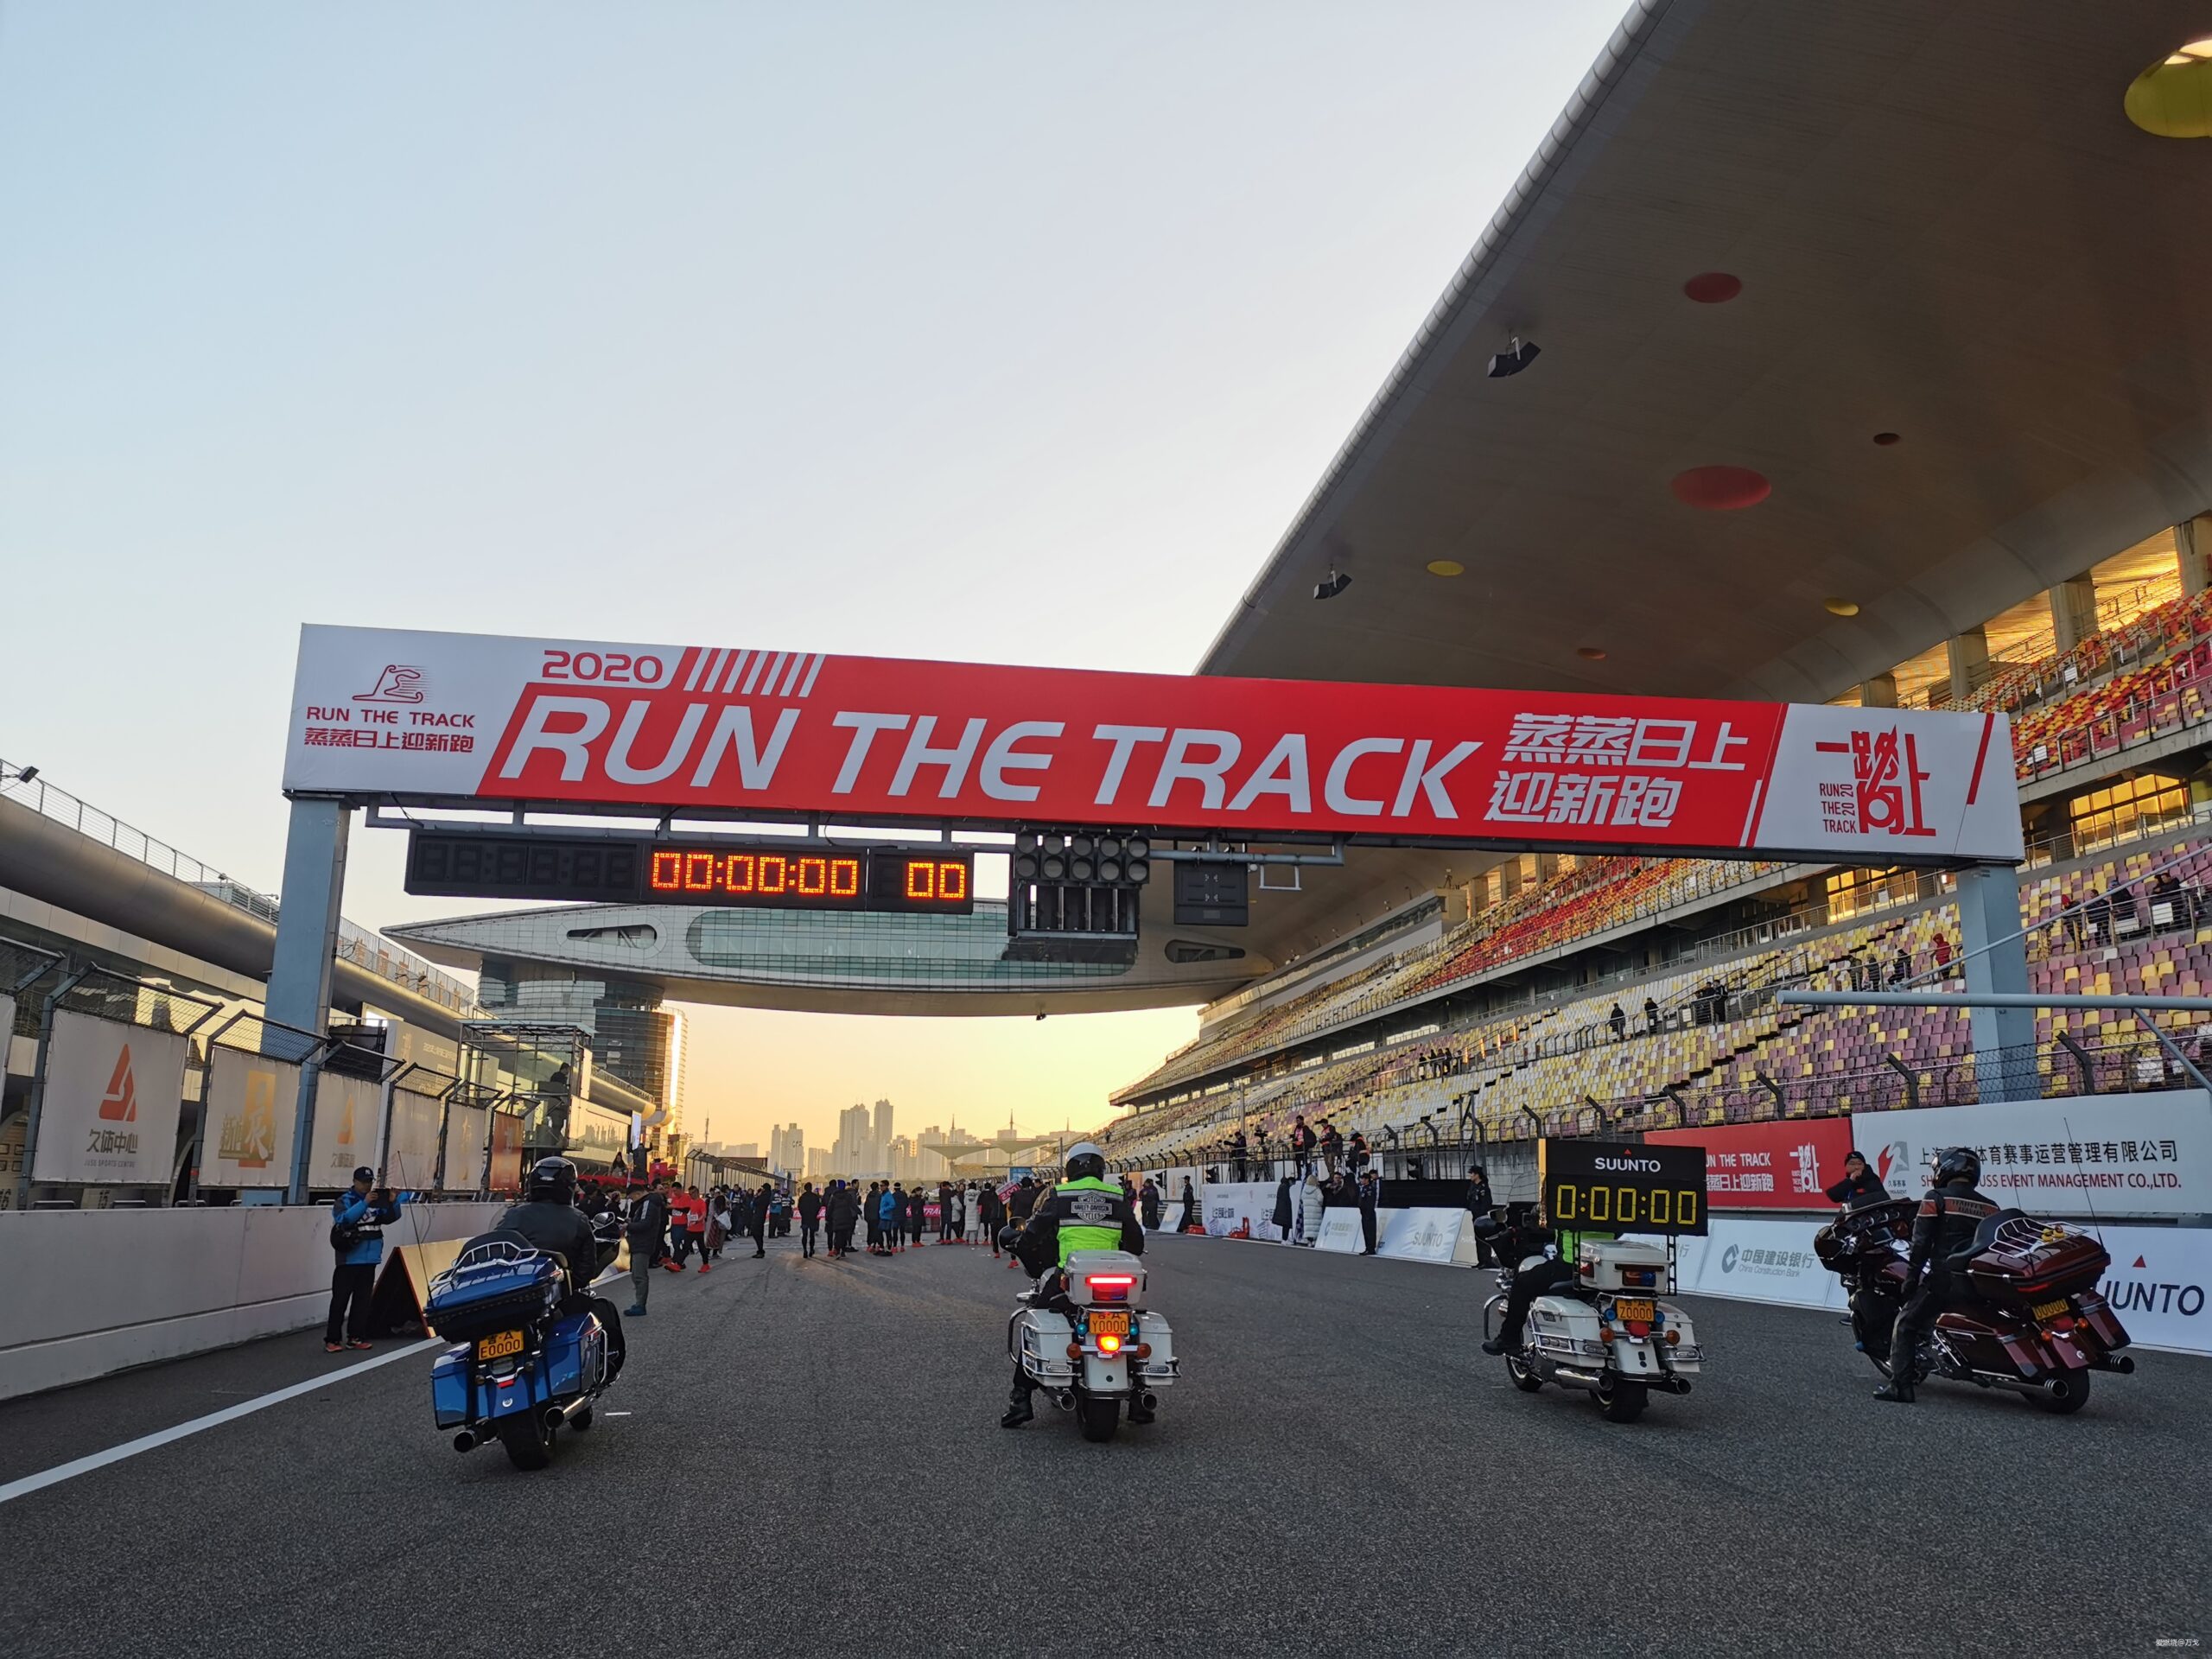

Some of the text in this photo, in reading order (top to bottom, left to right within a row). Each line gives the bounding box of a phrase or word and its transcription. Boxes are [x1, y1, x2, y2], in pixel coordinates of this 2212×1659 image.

[543, 650, 663, 683] 2020
[306, 706, 475, 728] RUN THE TRACK
[304, 728, 474, 753] 蒸蒸日上迎新跑
[1501, 712, 1748, 771] 蒸蒸日上
[499, 695, 1484, 820] RUN THE TRACK
[1483, 769, 1682, 828] 迎新跑
[1820, 783, 1840, 798] RUN
[1821, 801, 1840, 815] THE
[1822, 819, 1857, 834] TRACK
[652, 852, 965, 899] 00:00:00 00
[1719, 1154, 1737, 1167] THE
[1739, 1153, 1771, 1166] TRACK
[1919, 1140, 2177, 1166] 上体育赛事运营管理有限公司
[1594, 1157, 1662, 1173] SUUNTO
[1707, 1173, 1774, 1192] 蒸日上迎新跑
[1979, 1174, 1999, 1187] USS
[2000, 1174, 2035, 1188] EVENT
[2037, 1173, 2125, 1188] MANAGEMENT
[1556, 1185, 1697, 1225] 0:00:00
[1412, 1230, 1444, 1247] SUUNTO
[1741, 1249, 1815, 1268] 中国建设银行
[2104, 1281, 2204, 1316] UNTO
[1619, 1306, 1652, 1320] Z0000
[1092, 1320, 1127, 1333] Y0000
[480, 1339, 520, 1358] E0000
